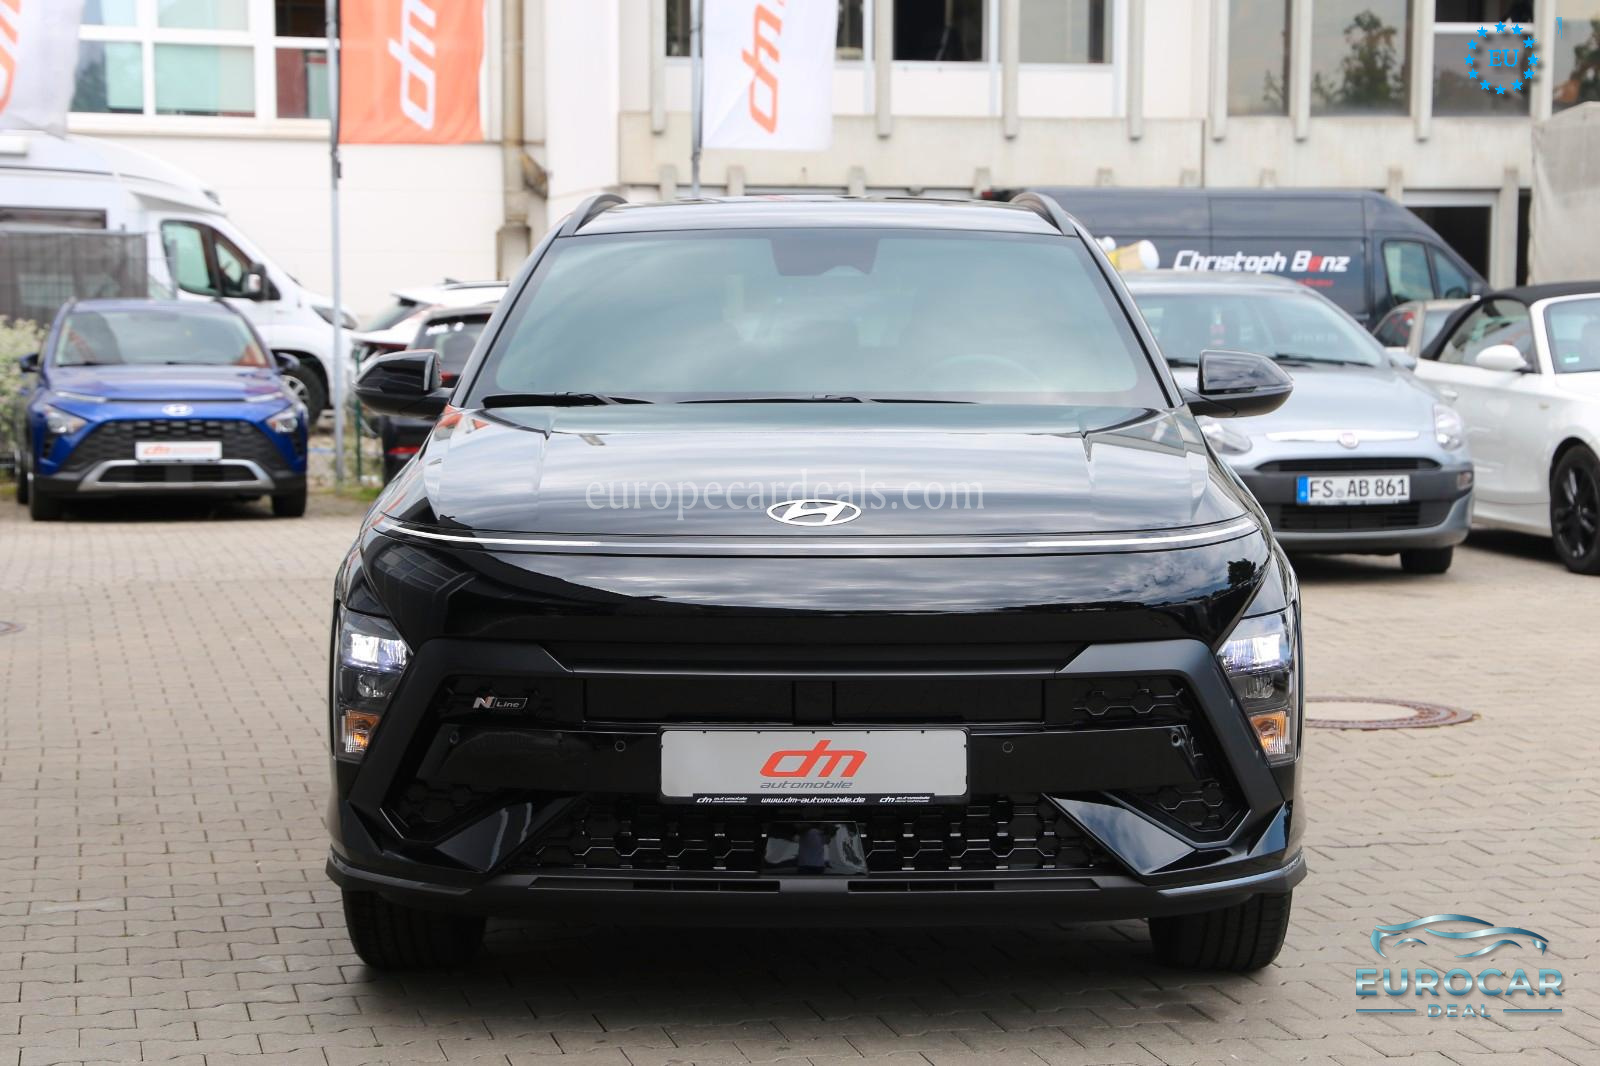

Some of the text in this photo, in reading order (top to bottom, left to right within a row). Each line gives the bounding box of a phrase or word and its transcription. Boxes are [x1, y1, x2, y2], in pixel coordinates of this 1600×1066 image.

[1174, 250, 1287, 273] Christoph
[759, 739, 868, 777] dm
[760, 780, 853, 789] automobile
